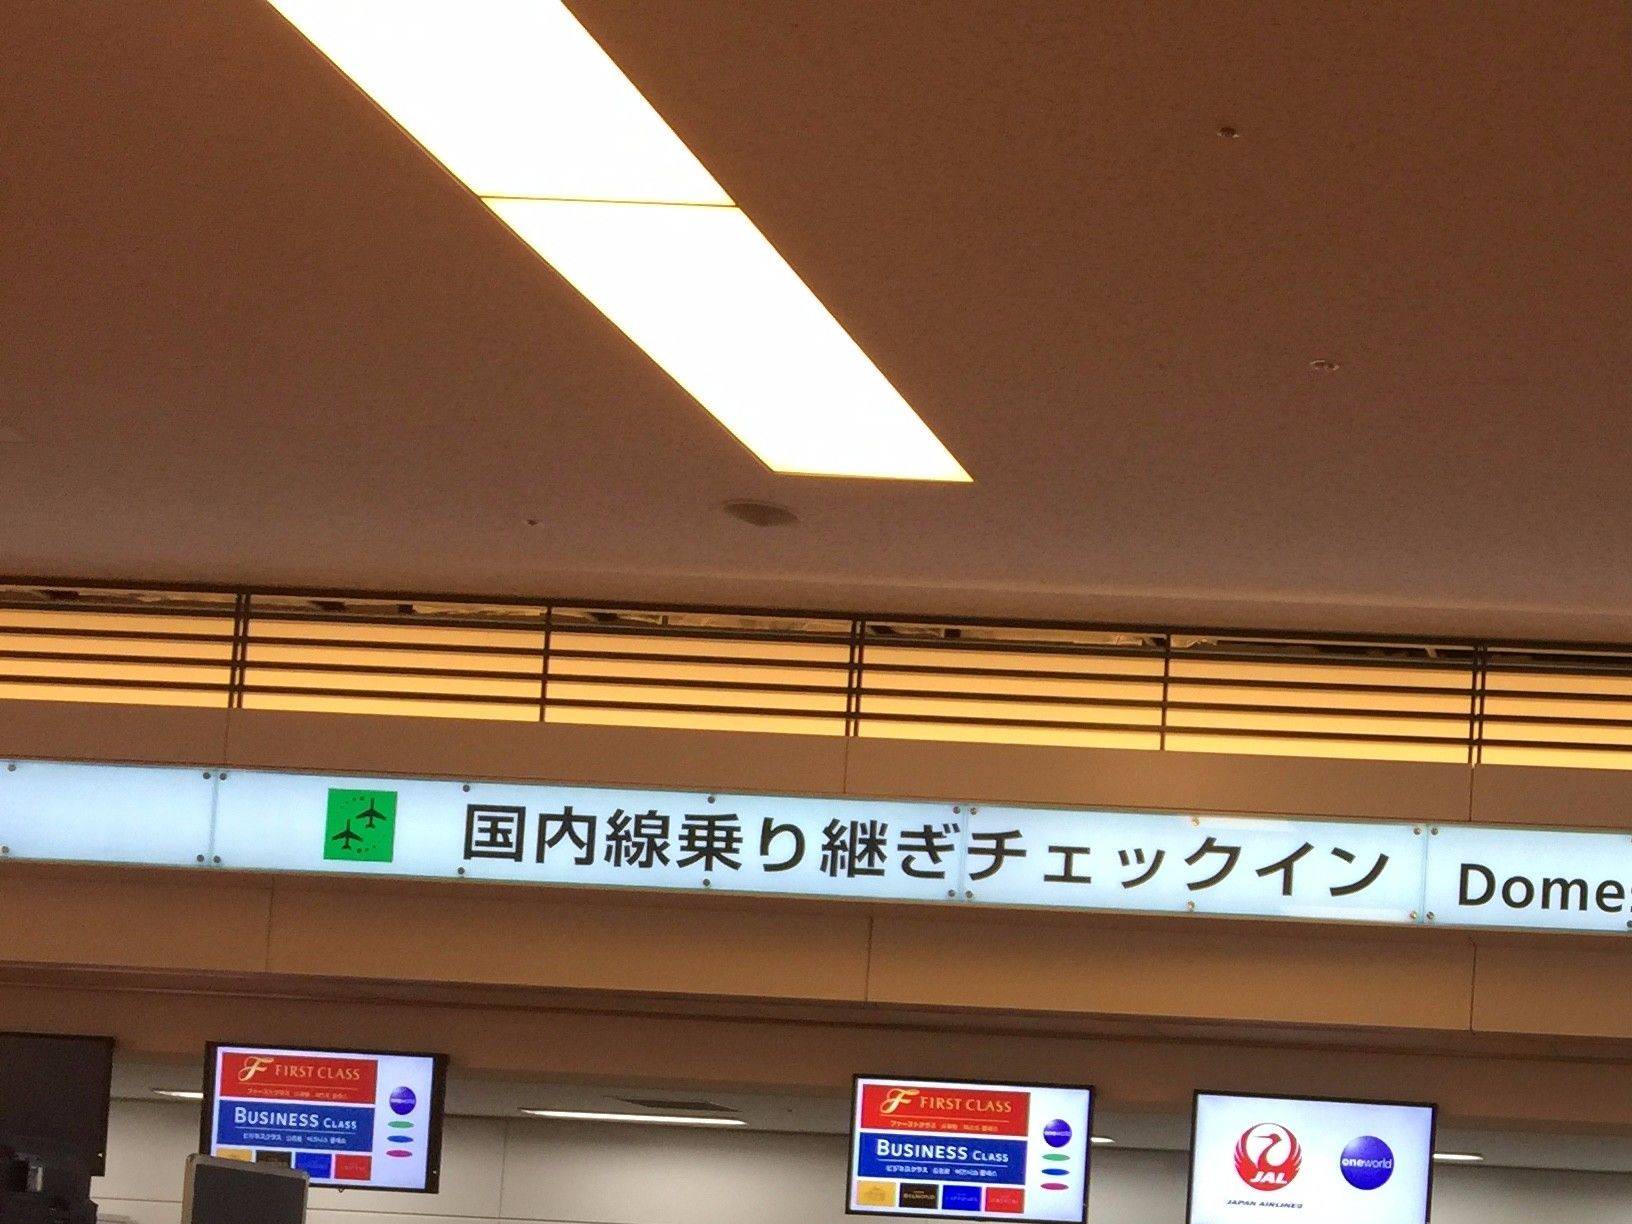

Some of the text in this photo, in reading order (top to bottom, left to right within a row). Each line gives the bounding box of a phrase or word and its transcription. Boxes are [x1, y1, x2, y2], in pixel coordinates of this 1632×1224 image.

[463, 803, 1390, 898] 国内線乗り継ぎチェックイン
[275, 1064, 314, 1079] FIRST
[317, 1067, 361, 1081] CLASS
[920, 1095, 960, 1110] FIRST
[965, 1098, 1012, 1114] CLASS
[234, 1106, 358, 1130] BUSINESS CLASS
[876, 1138, 1009, 1163] BUSINESS CLASS
[1341, 1157, 1392, 1169] oneworld
[1250, 1171, 1288, 1184] JAL
